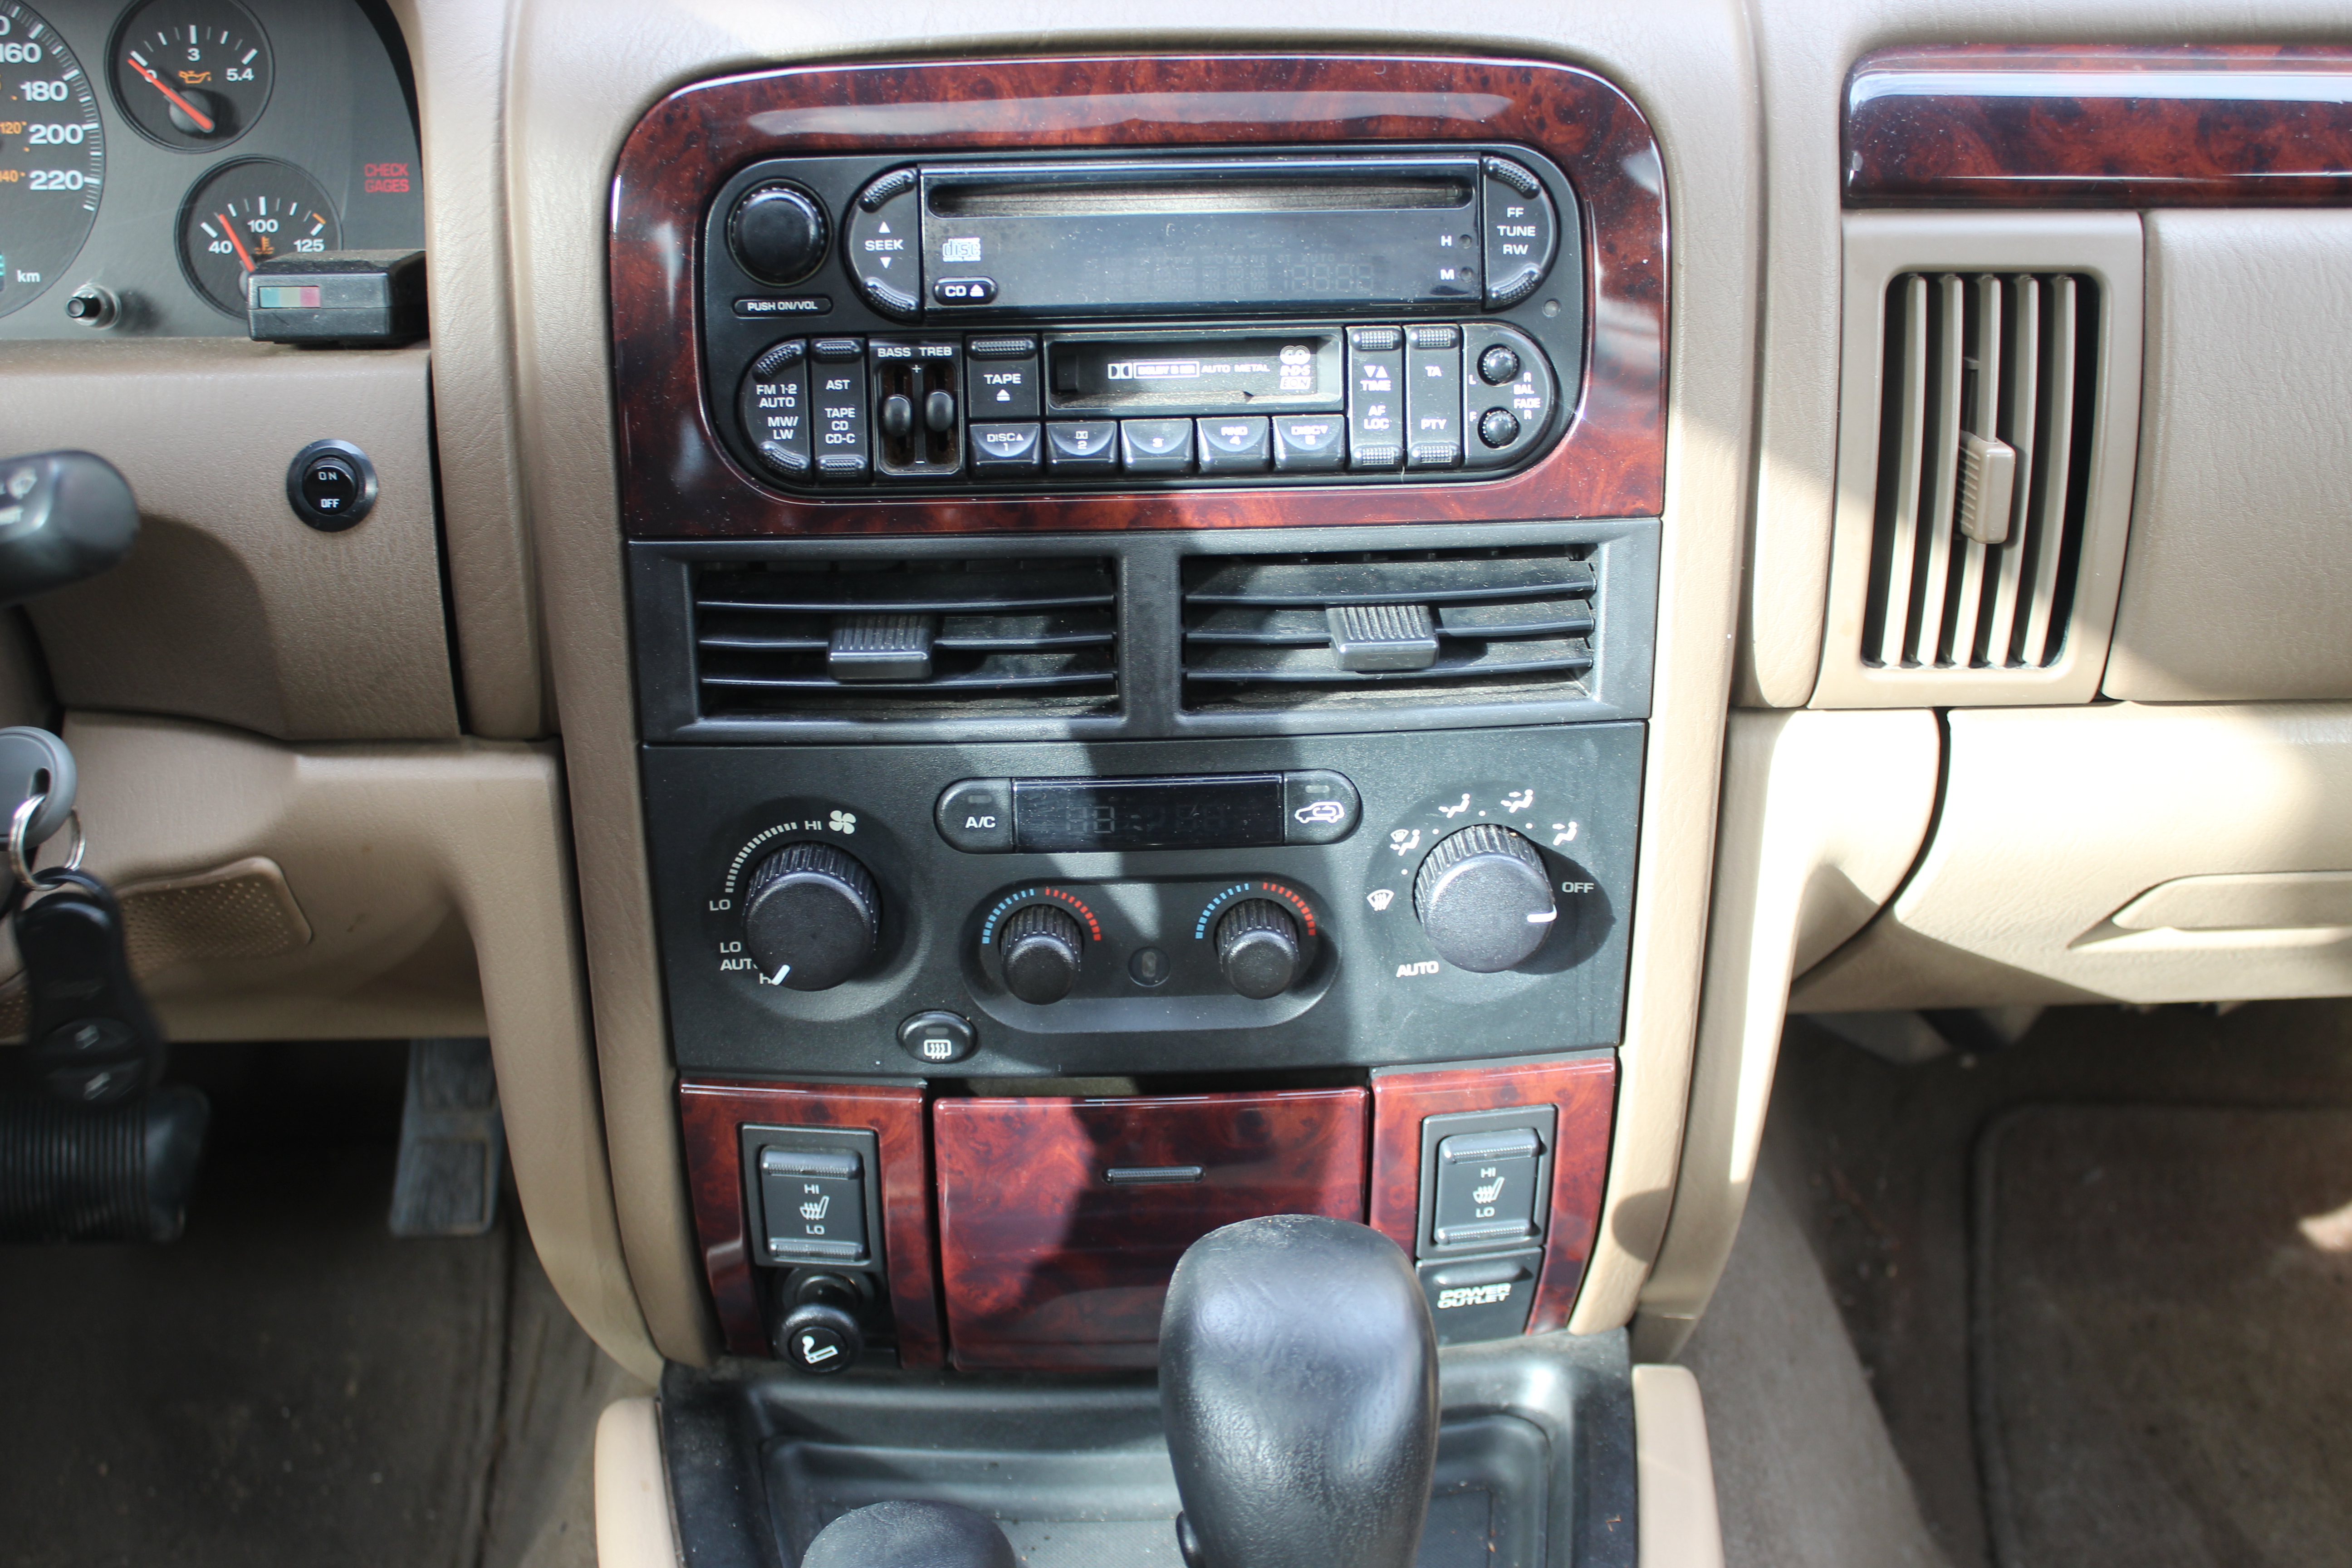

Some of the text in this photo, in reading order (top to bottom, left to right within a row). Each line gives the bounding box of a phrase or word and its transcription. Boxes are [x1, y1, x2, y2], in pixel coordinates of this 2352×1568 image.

[0, 42, 42, 63] 160
[187, 48, 201, 62] 3
[226, 68, 254, 82] 5.4
[20, 81, 69, 102] 180
[29, 124, 84, 145] 200
[364, 163, 409, 176] CHECK
[29, 170, 84, 191] 220
[365, 178, 410, 192] GAGES
[1506, 207, 1524, 218] FF
[247, 219, 279, 233] 100
[1497, 225, 1536, 237] TUNE
[294, 239, 325, 253] 125
[865, 239, 903, 251] SEEK
[1441, 235, 1452, 247] H
[208, 240, 232, 254] 40
[1503, 244, 1529, 255] RW
[17, 269, 40, 282] km
[1440, 269, 1455, 280] M
[945, 285, 966, 297] CD
[747, 300, 818, 311] PUSH ON/VOL
[877, 348, 911, 358] BASS
[918, 347, 952, 357] TREB
[1201, 364, 1230, 373] AUTO
[1234, 363, 1270, 372] METAL
[1425, 366, 1442, 377] TA
[983, 373, 1022, 385] TAPE
[1283, 378, 1308, 387] EON
[1469, 375, 1476, 385] L
[1524, 372, 1532, 382] R
[756, 384, 777, 395] FM
[826, 380, 850, 390] AST
[1360, 380, 1391, 391] TIME
[1514, 384, 1534, 395] BAL
[759, 398, 796, 408] AUTO
[1514, 398, 1541, 409] FADE
[825, 408, 856, 418] TAPE
[1368, 406, 1386, 416] AF
[1524, 409, 1532, 420] R
[768, 416, 799, 426] MW/
[1469, 412, 1477, 422] F
[831, 421, 848, 431] CD
[1364, 419, 1389, 430] LOC
[1421, 419, 1447, 430] PTY
[773, 430, 794, 440] LW
[1221, 426, 1248, 436] RND
[1291, 426, 1320, 436] DISC
[825, 434, 856, 444] CD-C
[986, 433, 1016, 442] DISC
[1152, 438, 1163, 448] 3
[1230, 436, 1241, 445] 4
[1305, 436, 1316, 445] 5
[1003, 443, 1009, 451] 1
[1077, 441, 1088, 449] 2
[318, 471, 338, 480] ON
[320, 499, 340, 508] OFF
[804, 820, 822, 830] HI
[965, 815, 996, 829] A/C
[1562, 882, 1595, 893] OFF
[709, 899, 731, 911] LO
[720, 941, 742, 953] LO
[1396, 960, 1440, 978] AUTO
[1480, 1167, 1496, 1178] HI
[804, 1184, 820, 1195] HI
[1475, 1206, 1495, 1218] LO
[805, 1225, 825, 1235] LO
[1440, 1282, 1511, 1300] POWER
[1437, 1292, 1510, 1309] OUTLET
